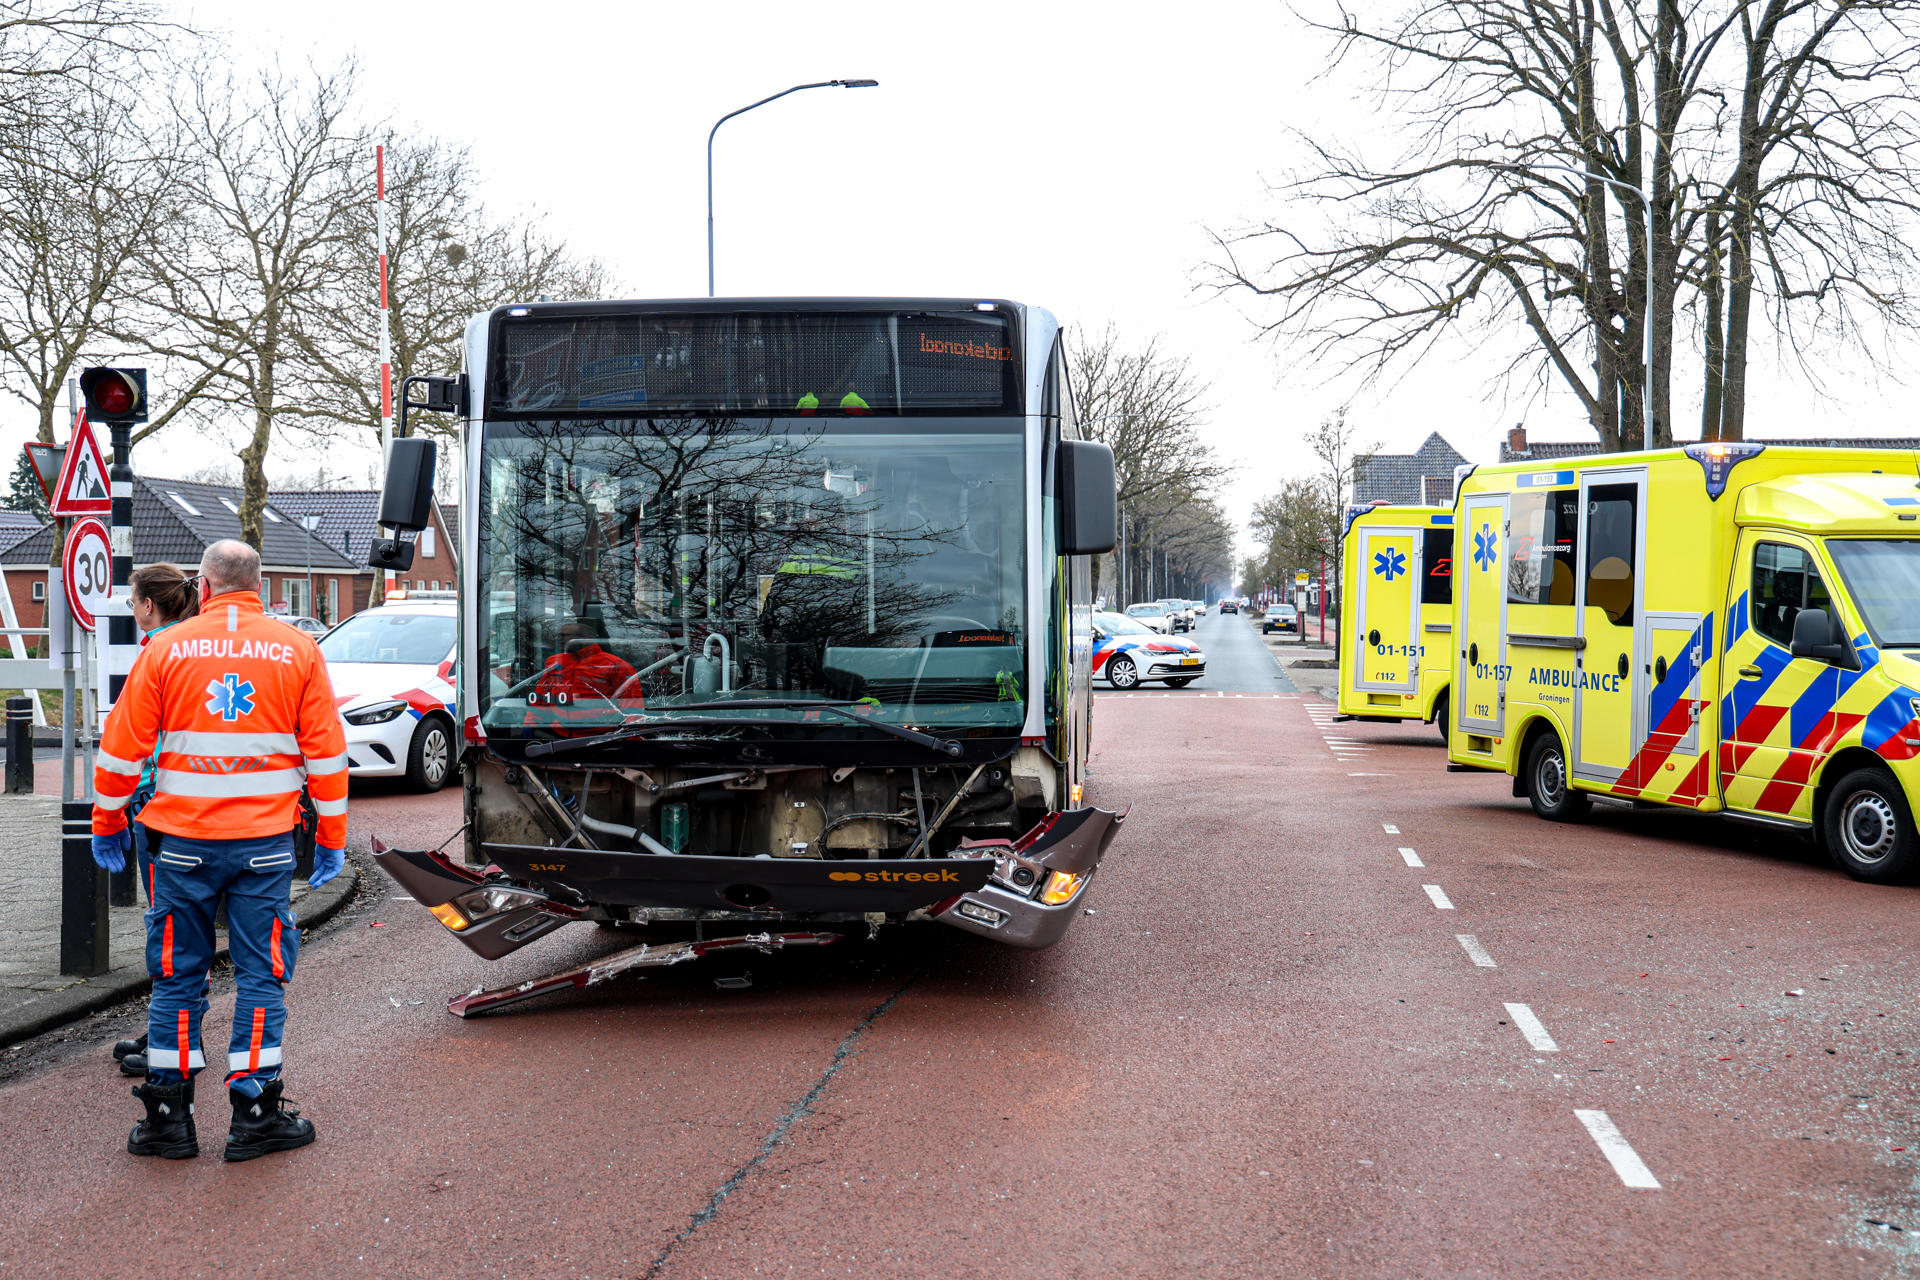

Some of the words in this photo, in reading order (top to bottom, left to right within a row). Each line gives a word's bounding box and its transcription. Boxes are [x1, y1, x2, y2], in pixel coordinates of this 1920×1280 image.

[79, 552, 107, 596] 30
[169, 639, 294, 664] AMBULANCE
[1377, 644, 1425, 657] 01-151
[1476, 663, 1512, 682] 01-157
[1528, 667, 1620, 692] AMBULANCE
[1539, 692, 1570, 704] Groningen
[528, 863, 566, 871] 3147
[864, 869, 960, 882] streek
